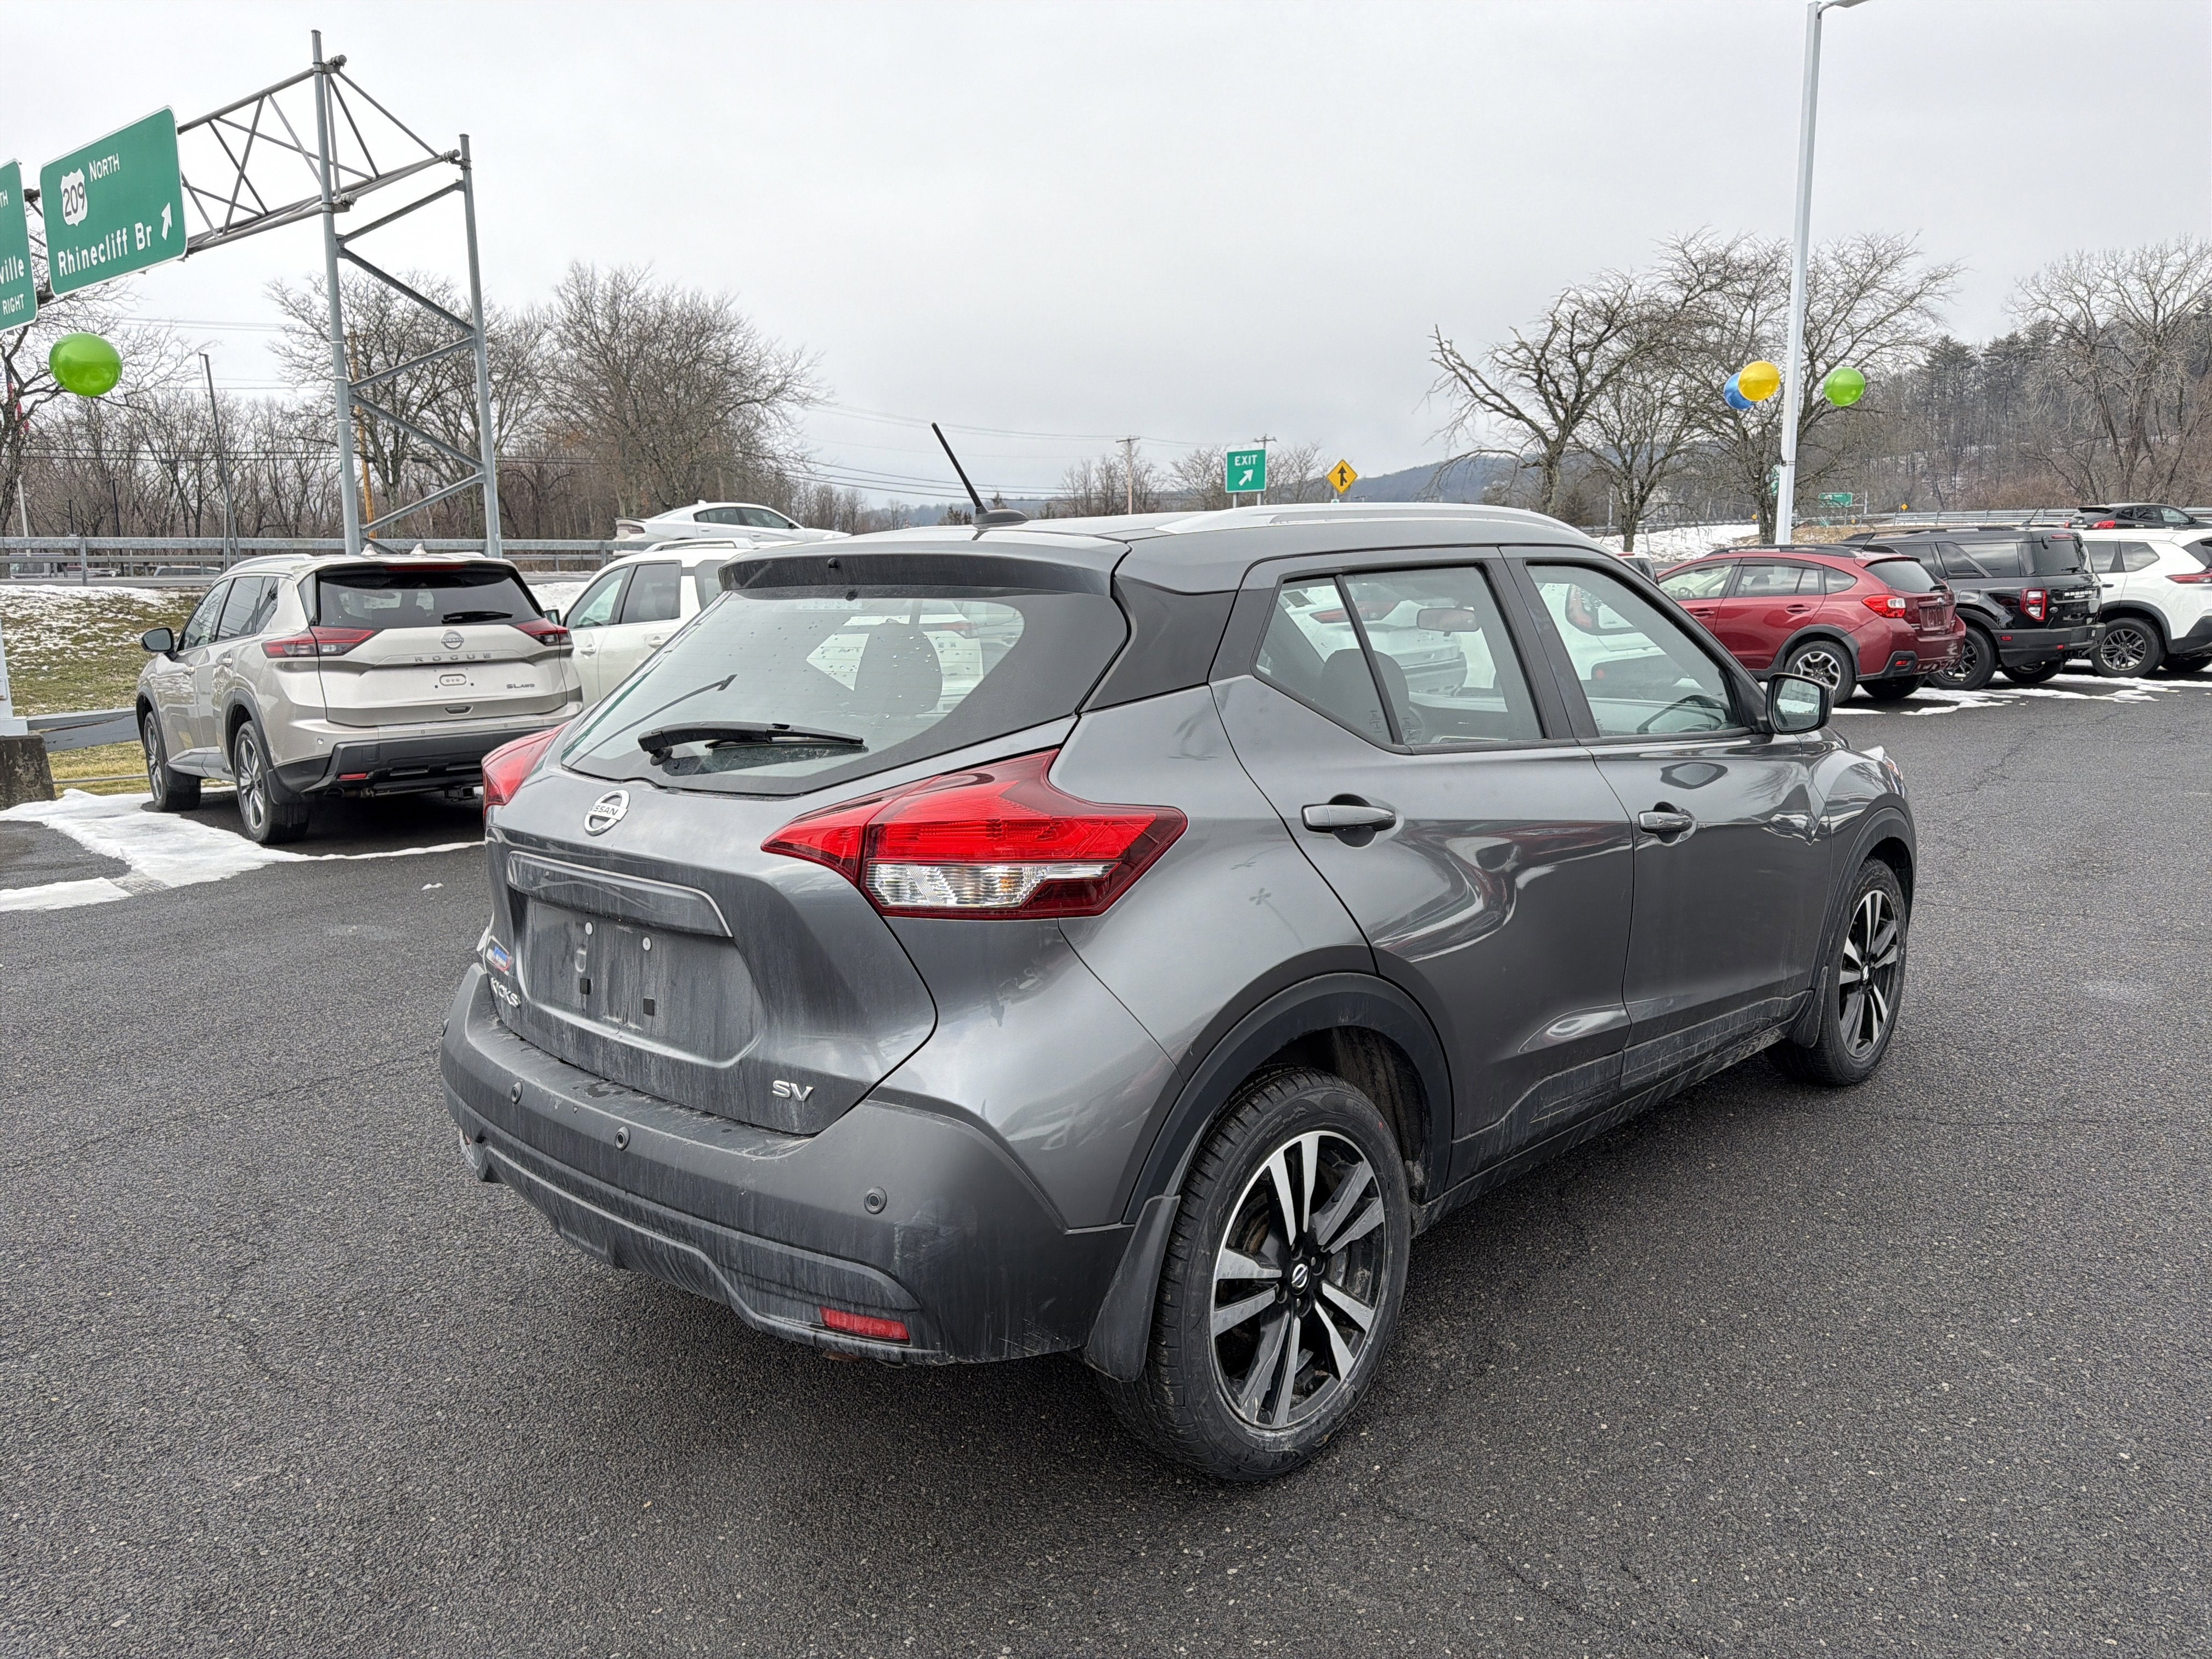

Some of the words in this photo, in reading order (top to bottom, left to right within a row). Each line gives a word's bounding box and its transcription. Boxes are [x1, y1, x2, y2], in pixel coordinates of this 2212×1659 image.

[89, 153, 120, 182] NORTH
[63, 182, 85, 217] 209
[58, 227, 128, 276] Rhinecliff
[135, 222, 152, 251] Br
[2, 294, 24, 315] RIGHT
[1234, 455, 1258, 466] EXIT
[414, 652, 492, 662] ROGUE
[772, 1080, 814, 1102] SV
